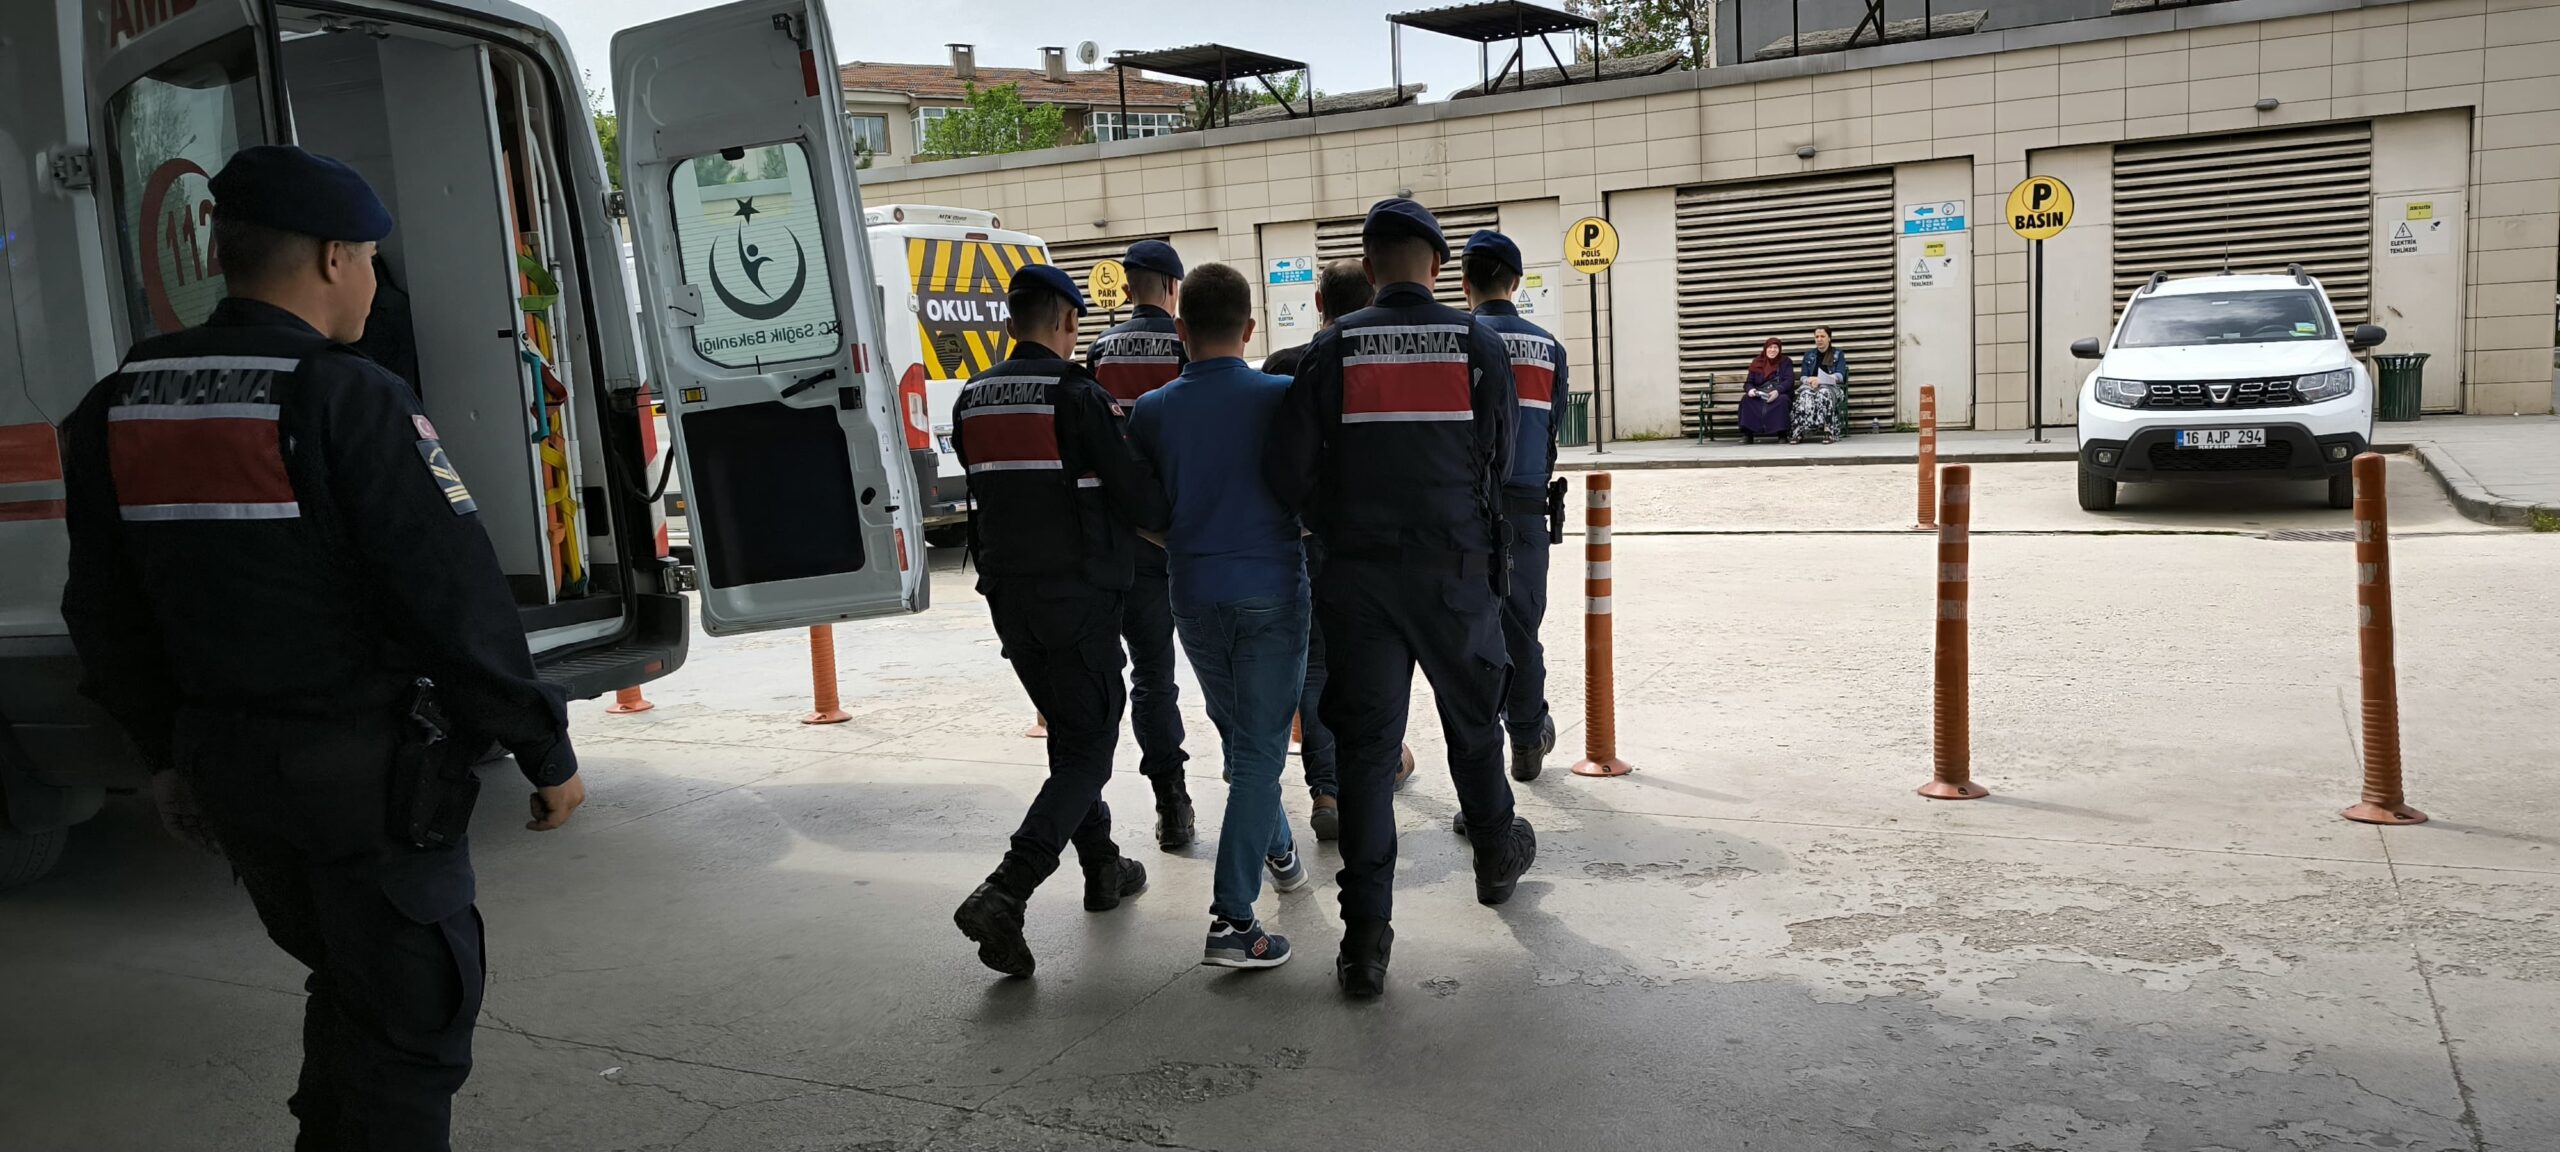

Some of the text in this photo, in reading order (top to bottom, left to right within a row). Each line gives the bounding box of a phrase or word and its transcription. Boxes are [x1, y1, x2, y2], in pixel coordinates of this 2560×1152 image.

[2032, 183, 2052, 210] P
[2015, 211, 2063, 230] BASIN
[165, 198, 224, 287] 112
[1583, 224, 1599, 248] P
[1573, 258, 1610, 267] JANDARMA
[1581, 249, 1601, 257] POLİS
[1098, 289, 1117, 297] PARK
[926, 299, 1011, 322] OKUL TA
[1102, 338, 1174, 356] JANDARMA
[1353, 332, 1461, 356] JANDARMA
[1504, 340, 1550, 361] ARMA
[123, 369, 274, 406] JANDARMA
[967, 383, 1046, 407] JANDARMA
[2186, 430, 2262, 444] 16 AJP 294
